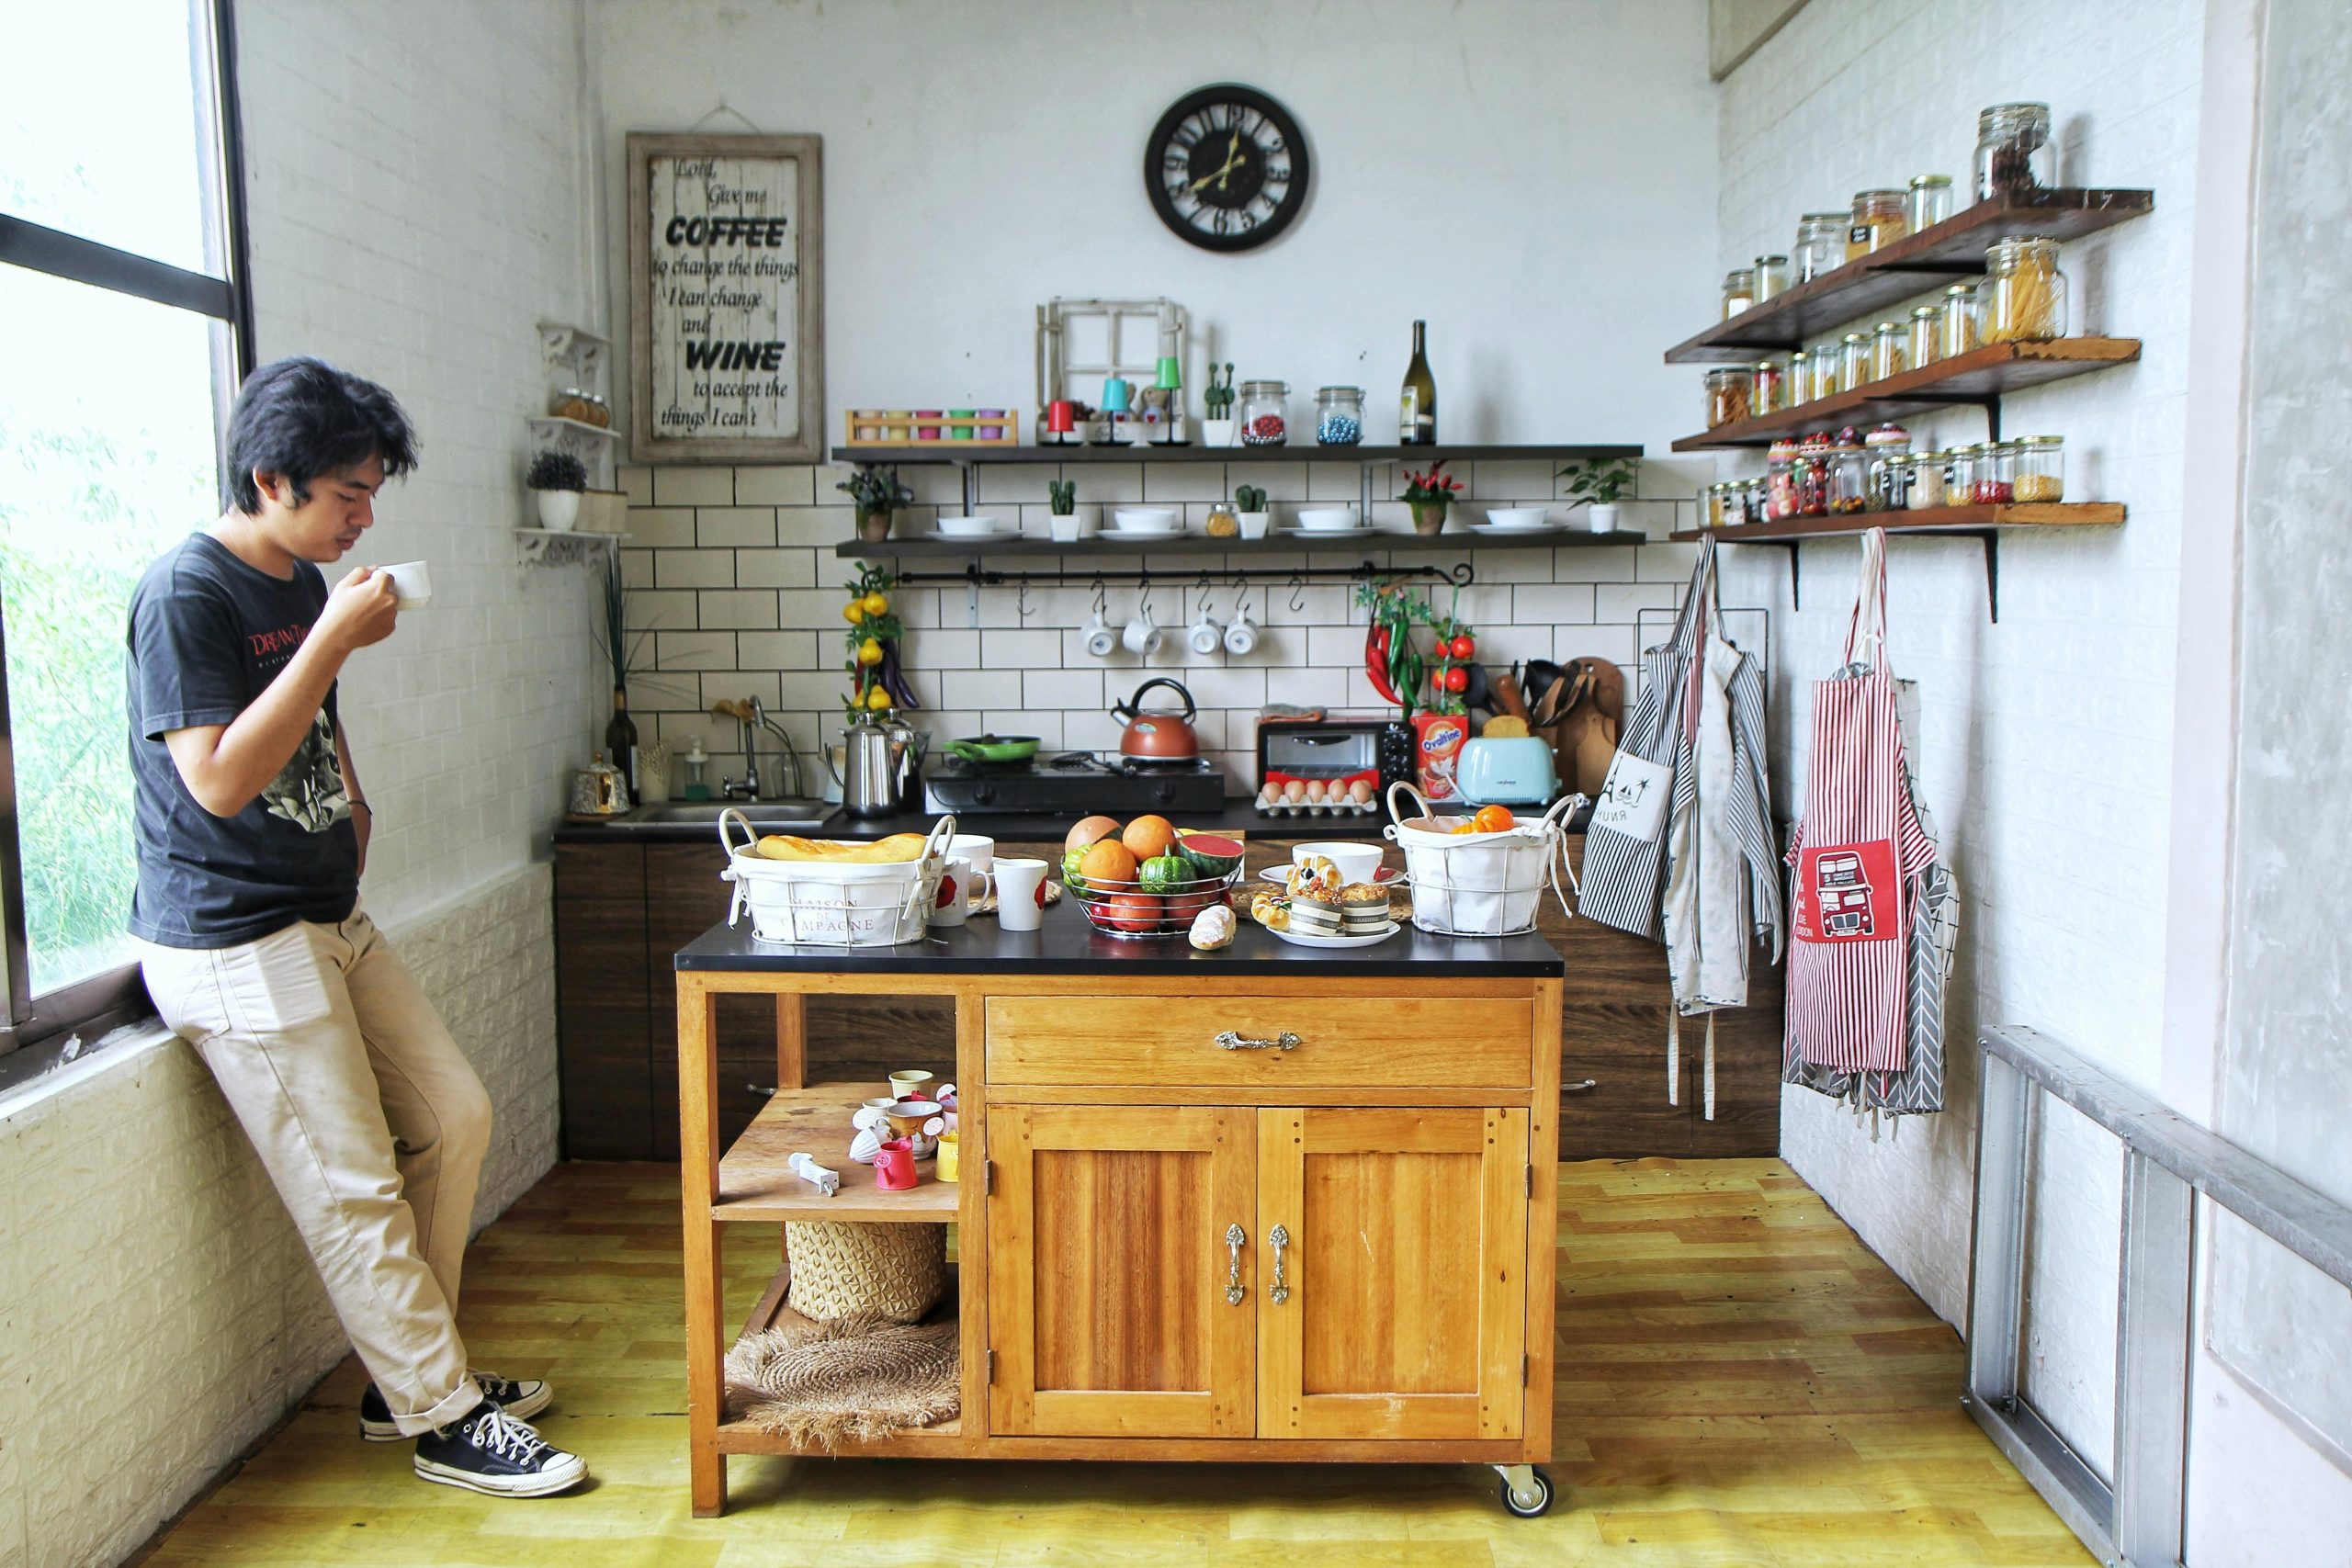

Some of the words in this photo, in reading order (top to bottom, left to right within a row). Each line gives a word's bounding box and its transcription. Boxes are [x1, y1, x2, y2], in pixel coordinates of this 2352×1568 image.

[675, 159, 718, 180] Lord,
[708, 184, 741, 208] Give
[744, 189, 766, 204] me
[665, 215, 787, 247] COFFEE
[652, 256, 668, 276] to
[672, 254, 725, 278] change
[728, 254, 752, 276] the
[753, 255, 798, 283] things
[669, 287, 677, 306] I
[678, 289, 706, 307] can
[710, 287, 762, 310] change
[682, 312, 711, 334] and
[685, 340, 786, 372] WINE
[694, 380, 710, 398] to
[712, 380, 762, 400] accept
[764, 377, 787, 398] the
[661, 406, 707, 432] things
[712, 407, 720, 426] I
[1424, 729, 1460, 750] Ovaltine
[781, 918, 874, 931] CMPAGNE
